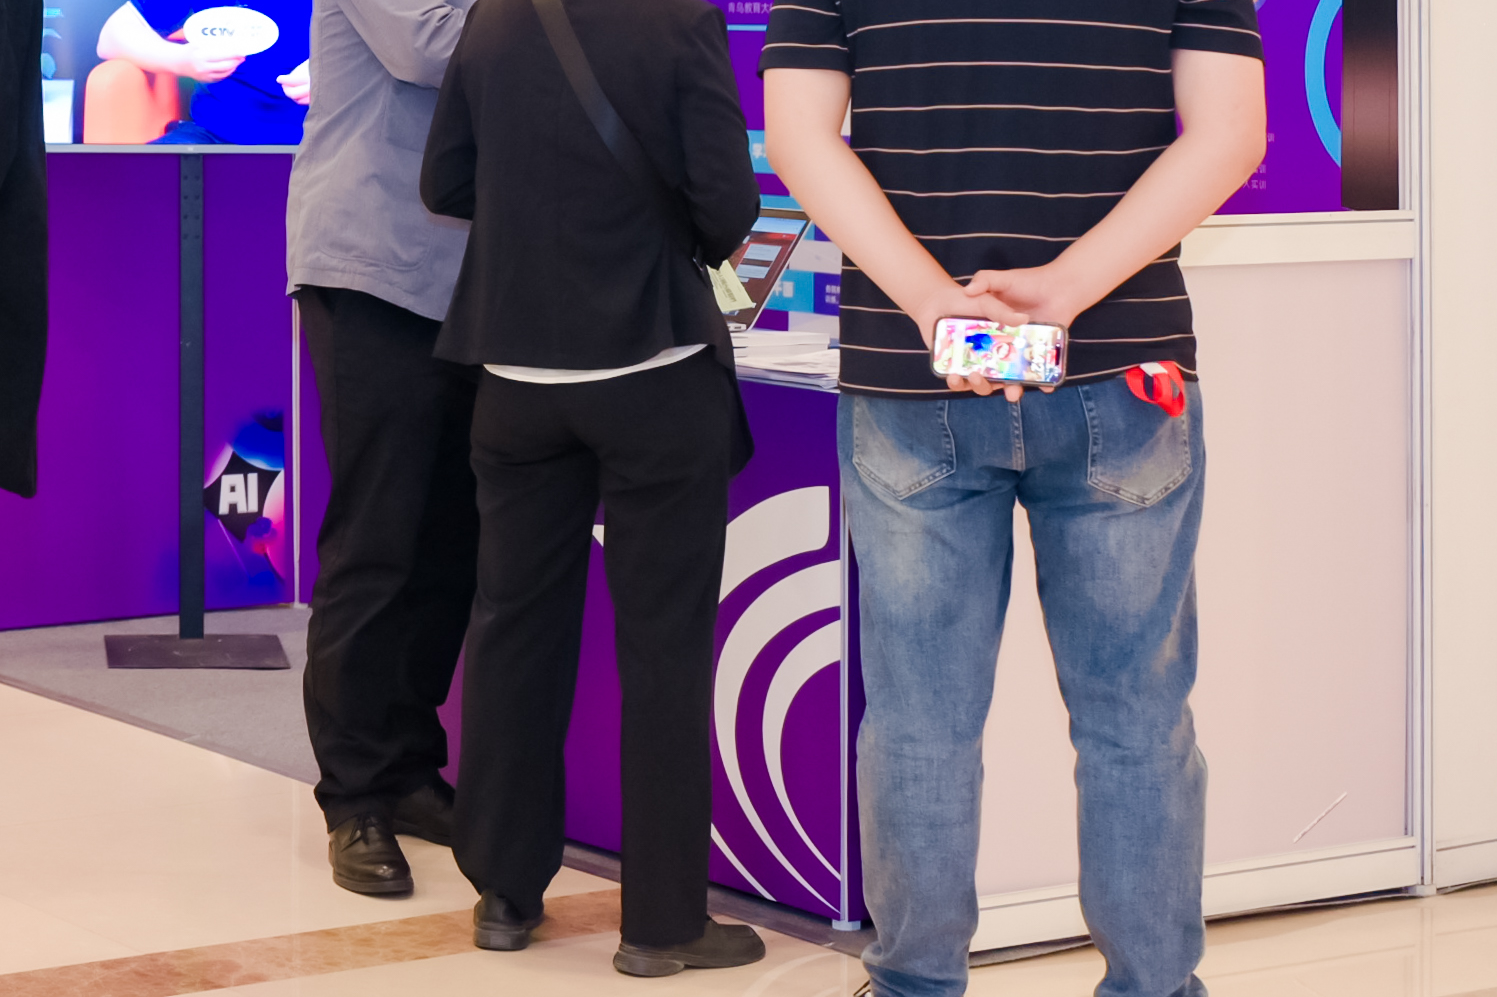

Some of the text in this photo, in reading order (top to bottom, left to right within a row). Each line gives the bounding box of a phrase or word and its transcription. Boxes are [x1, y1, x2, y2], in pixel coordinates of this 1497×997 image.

[728, 1, 773, 14] 青鸟教育大
[218, 472, 259, 515] AI
